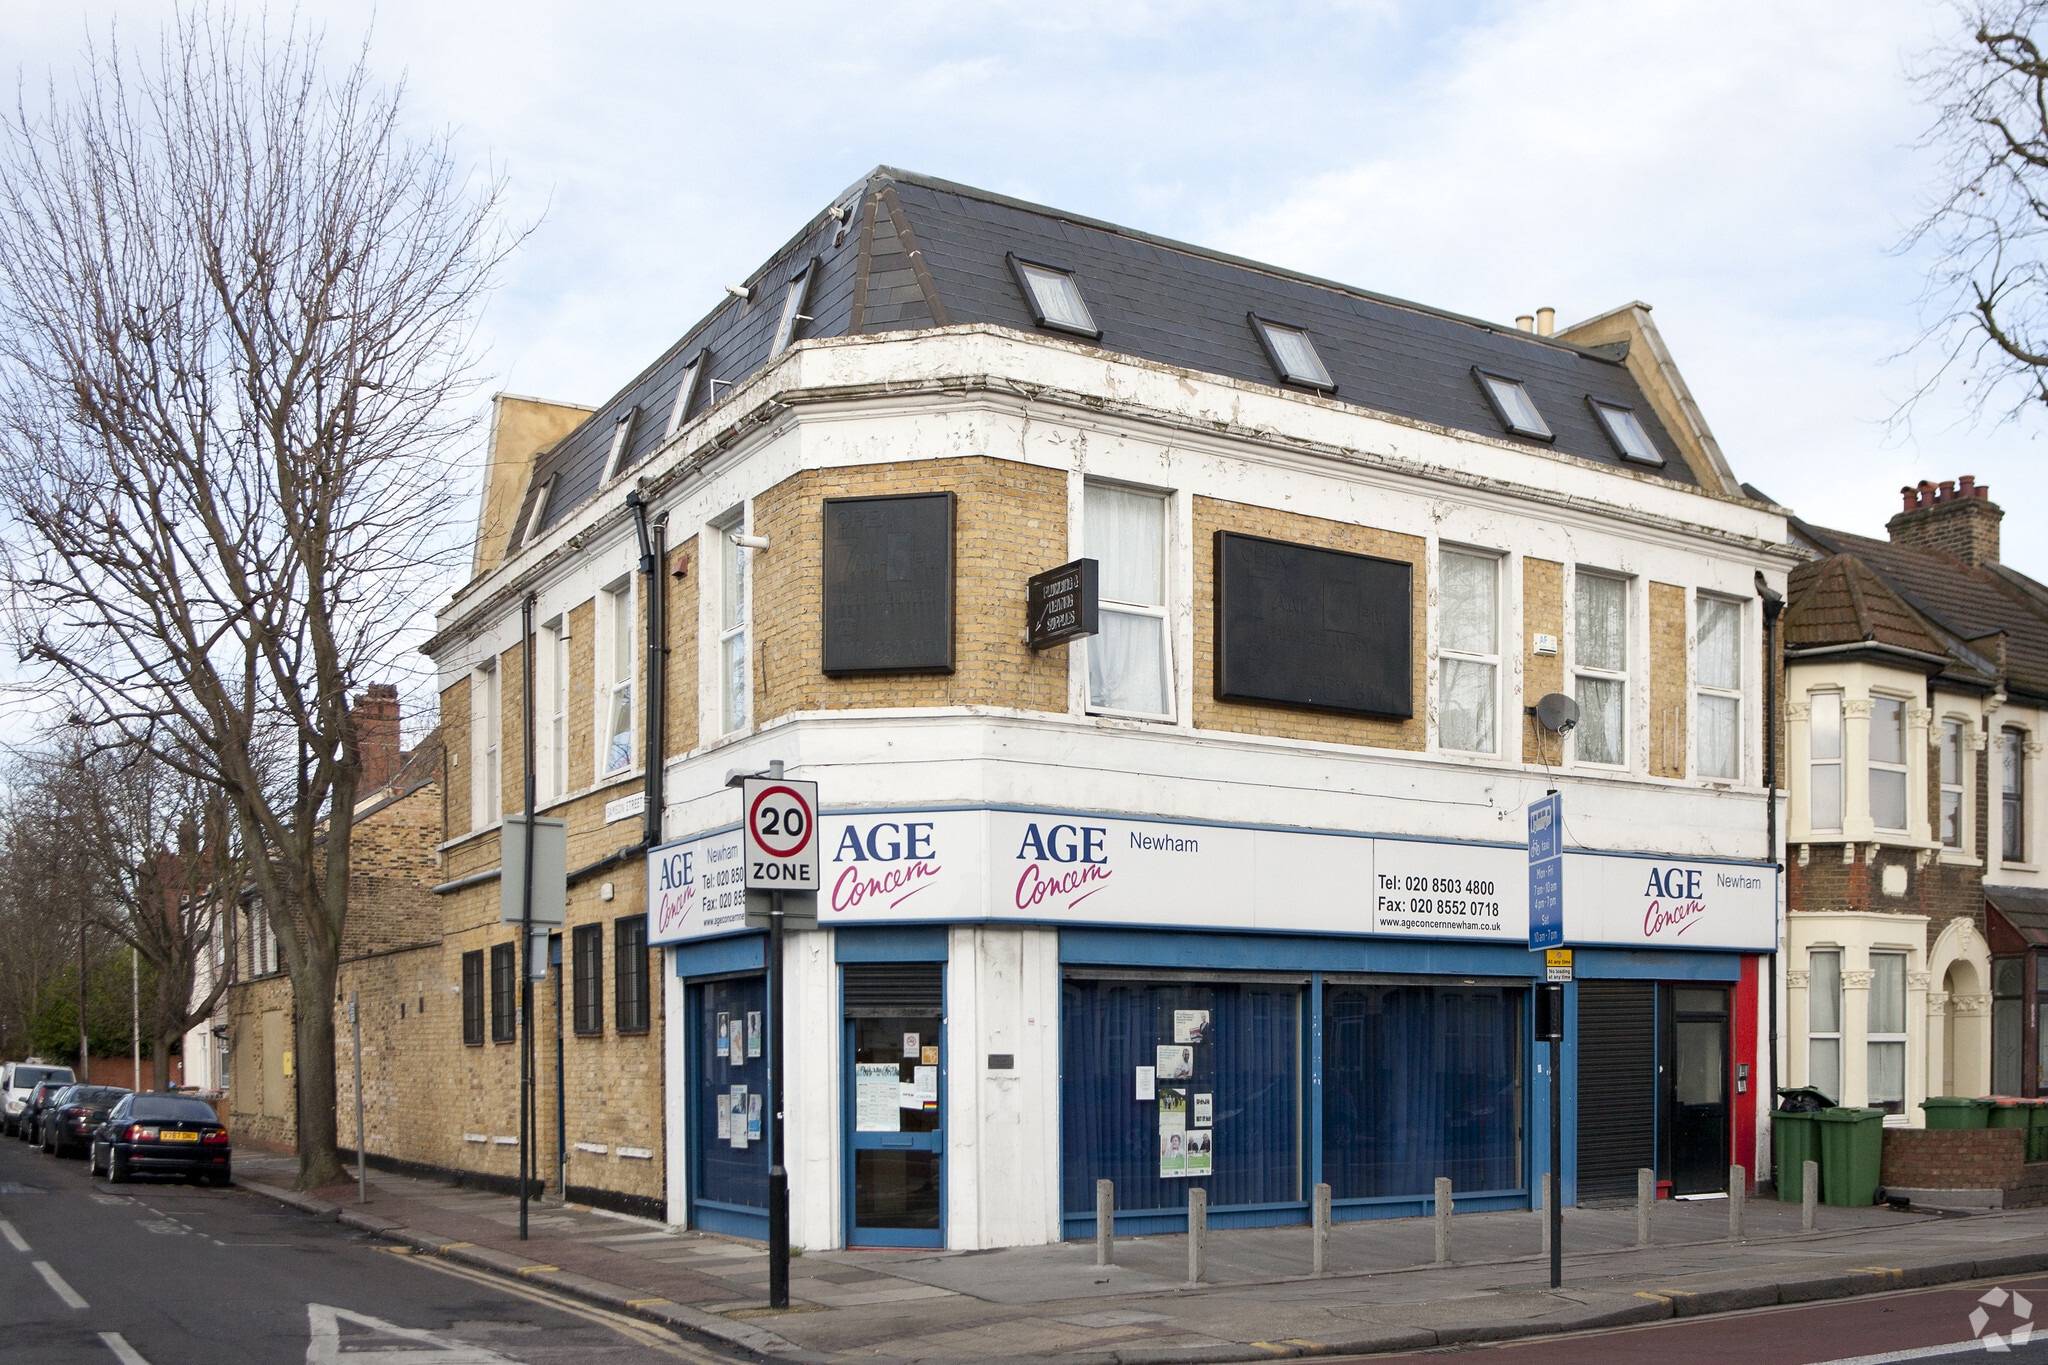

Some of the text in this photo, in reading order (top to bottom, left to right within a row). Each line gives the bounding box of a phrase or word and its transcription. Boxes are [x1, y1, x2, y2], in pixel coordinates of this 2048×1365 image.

[626, 797, 643, 812] STREET
[761, 807, 803, 836] 20
[833, 822, 936, 862] AGE
[1016, 823, 1198, 864] AGE Newham
[659, 844, 738, 891] AGE Newham
[702, 866, 744, 889] Tel: 020 850
[753, 862, 810, 881] ZONE
[832, 861, 941, 912] Concern
[1015, 864, 1113, 909] Concern
[1378, 874, 1494, 896] Tel: 020 8503 4800
[1644, 867, 1761, 899] AGE Newham
[659, 885, 696, 934] Concern
[702, 889, 745, 912] Fax: 020 855
[1378, 896, 1499, 917] Fax: 020 8552 0718
[703, 913, 744, 926] www.ageconcernne
[1380, 918, 1501, 931] www.ageconcernnewham.co.uk
[1541, 914, 1550, 926] Sat
[1644, 900, 1706, 937] Concern
